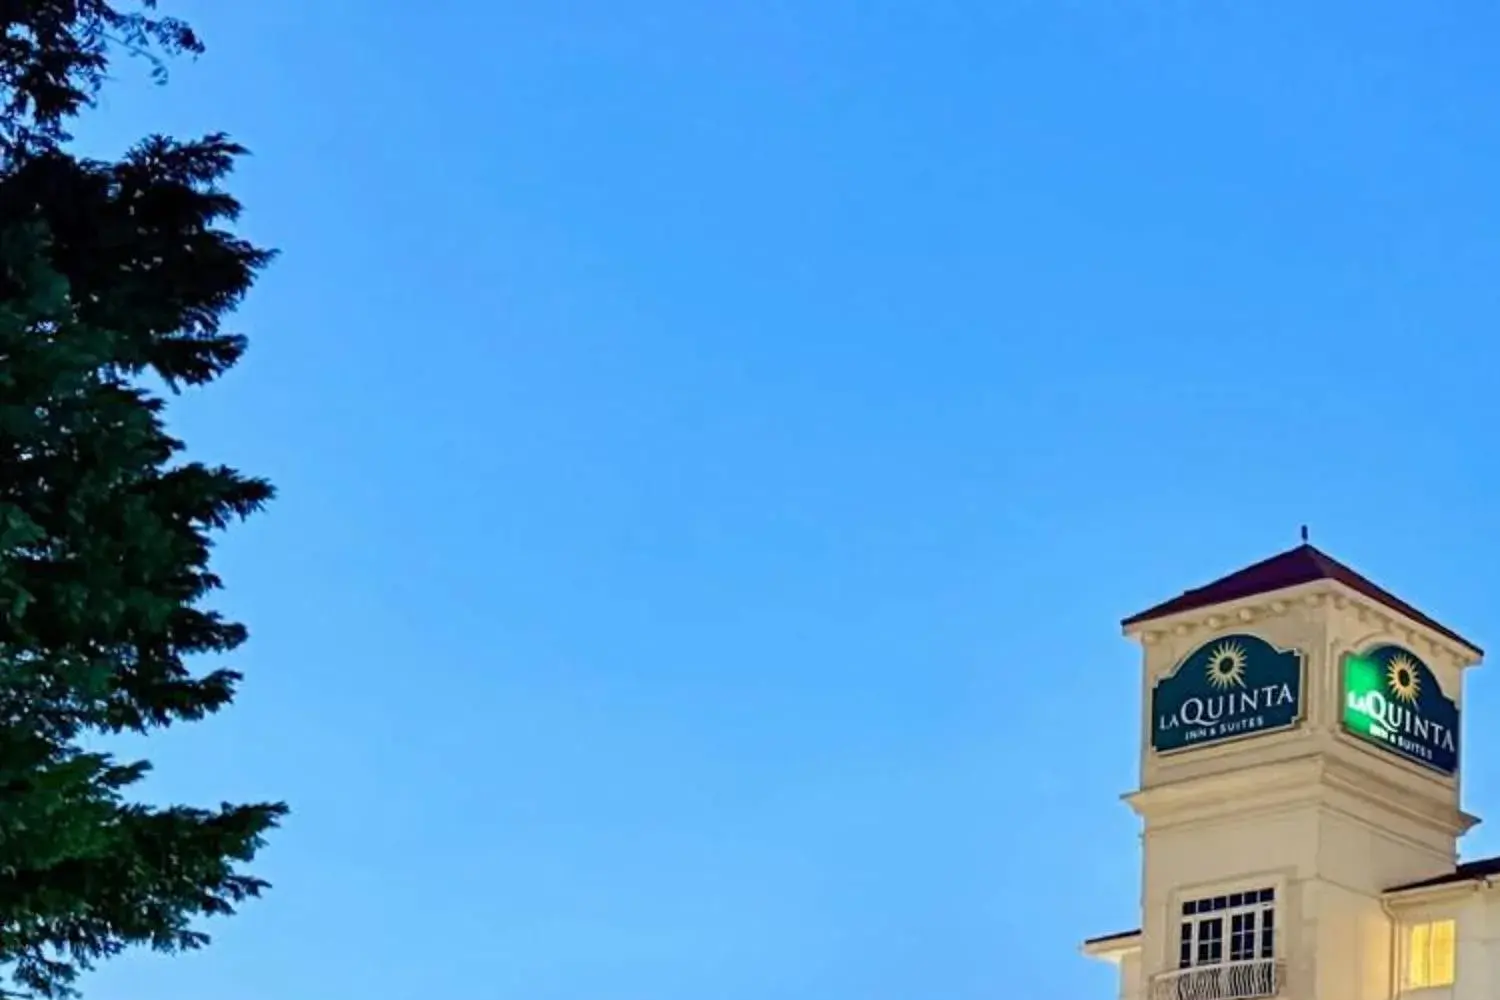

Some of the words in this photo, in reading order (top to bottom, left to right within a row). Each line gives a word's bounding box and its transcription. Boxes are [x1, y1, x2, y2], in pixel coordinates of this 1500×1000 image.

[1159, 714, 1180, 731] LA
[1180, 682, 1294, 727] QUINTA
[1365, 690, 1455, 753] QUINTA
